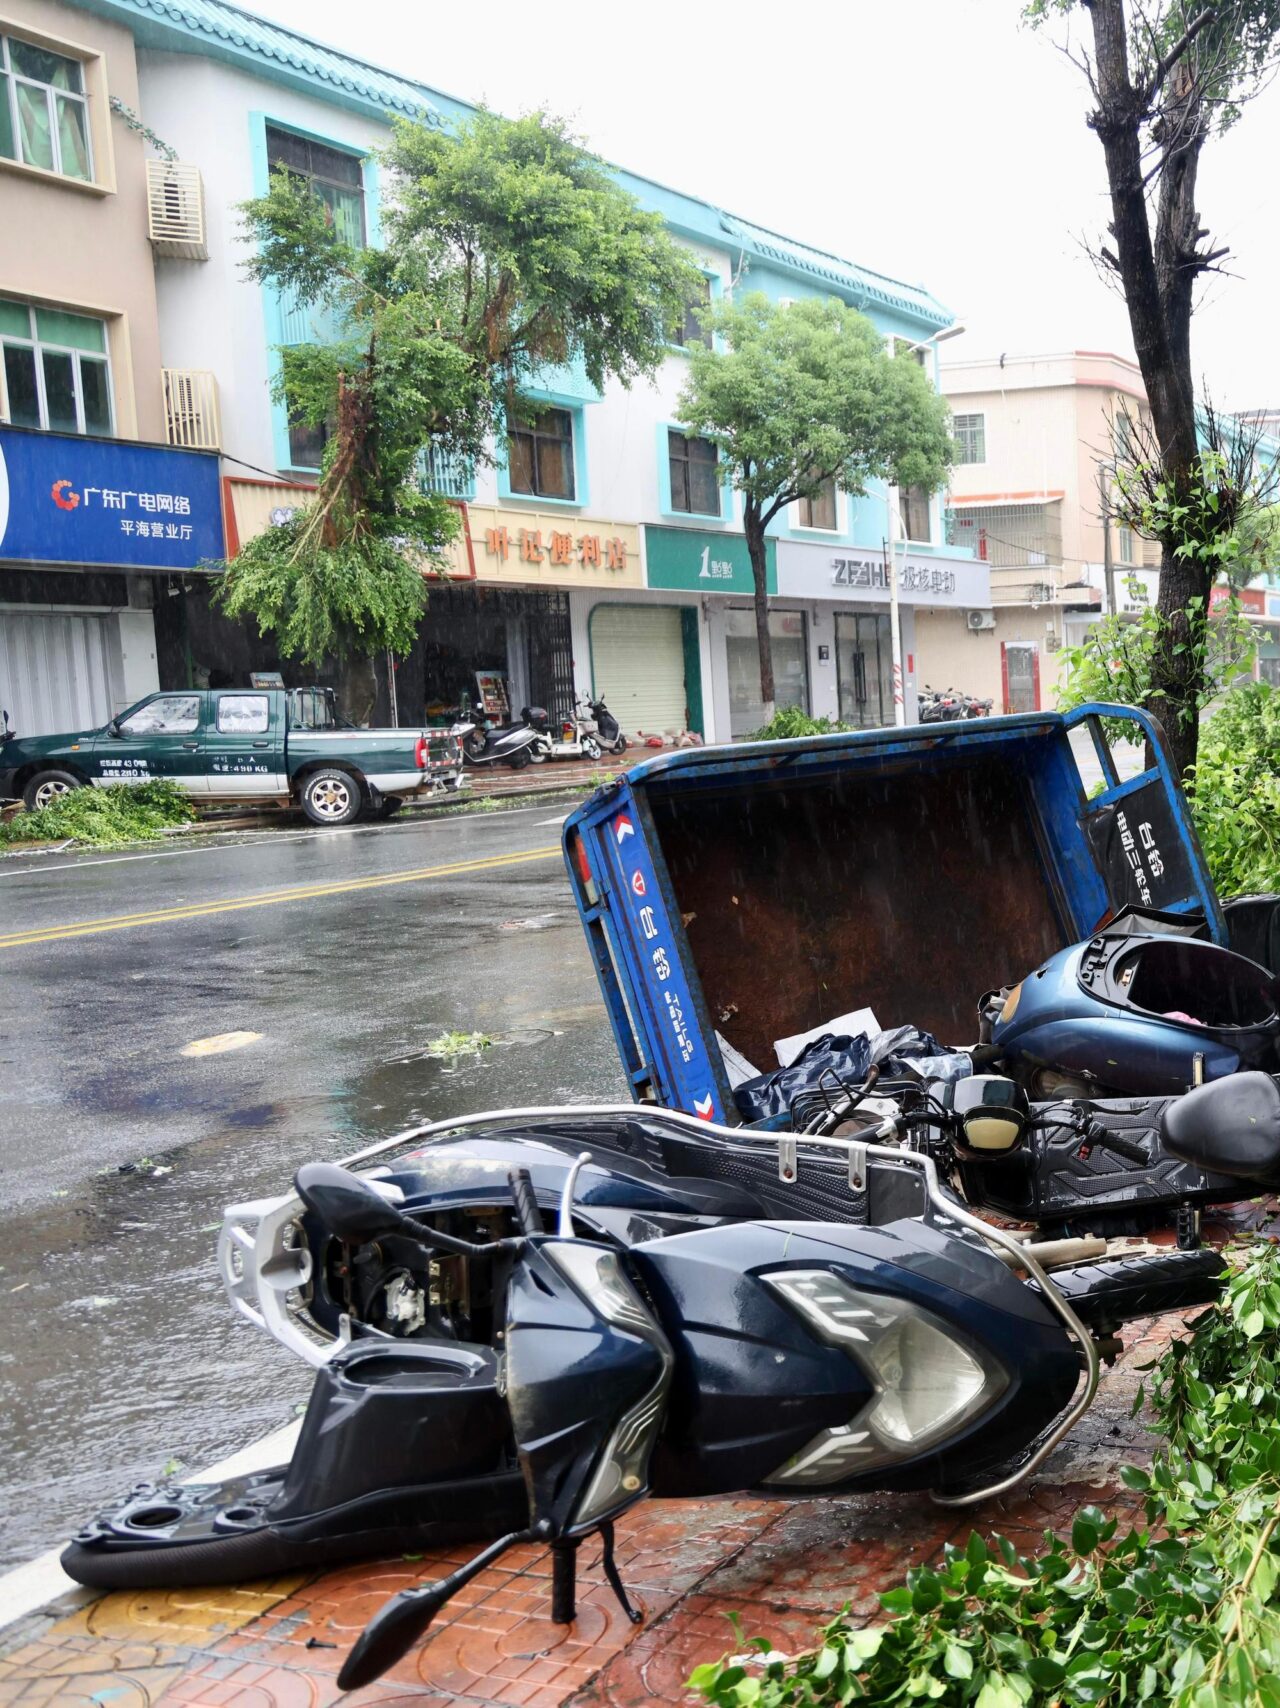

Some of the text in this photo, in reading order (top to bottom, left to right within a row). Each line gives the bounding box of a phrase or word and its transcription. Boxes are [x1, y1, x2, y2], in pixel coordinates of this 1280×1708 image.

[84, 488, 191, 515] 广东广电网络
[121, 520, 193, 540] 平海营业厅
[486, 526, 627, 569] 叶记便利店
[901, 566, 956, 593] 极核电动
[1116, 811, 1153, 907] 电动三轮车
[1138, 821, 1164, 877] 台铃
[639, 905, 671, 981] 台铃
[672, 993, 694, 1053] TAILG
